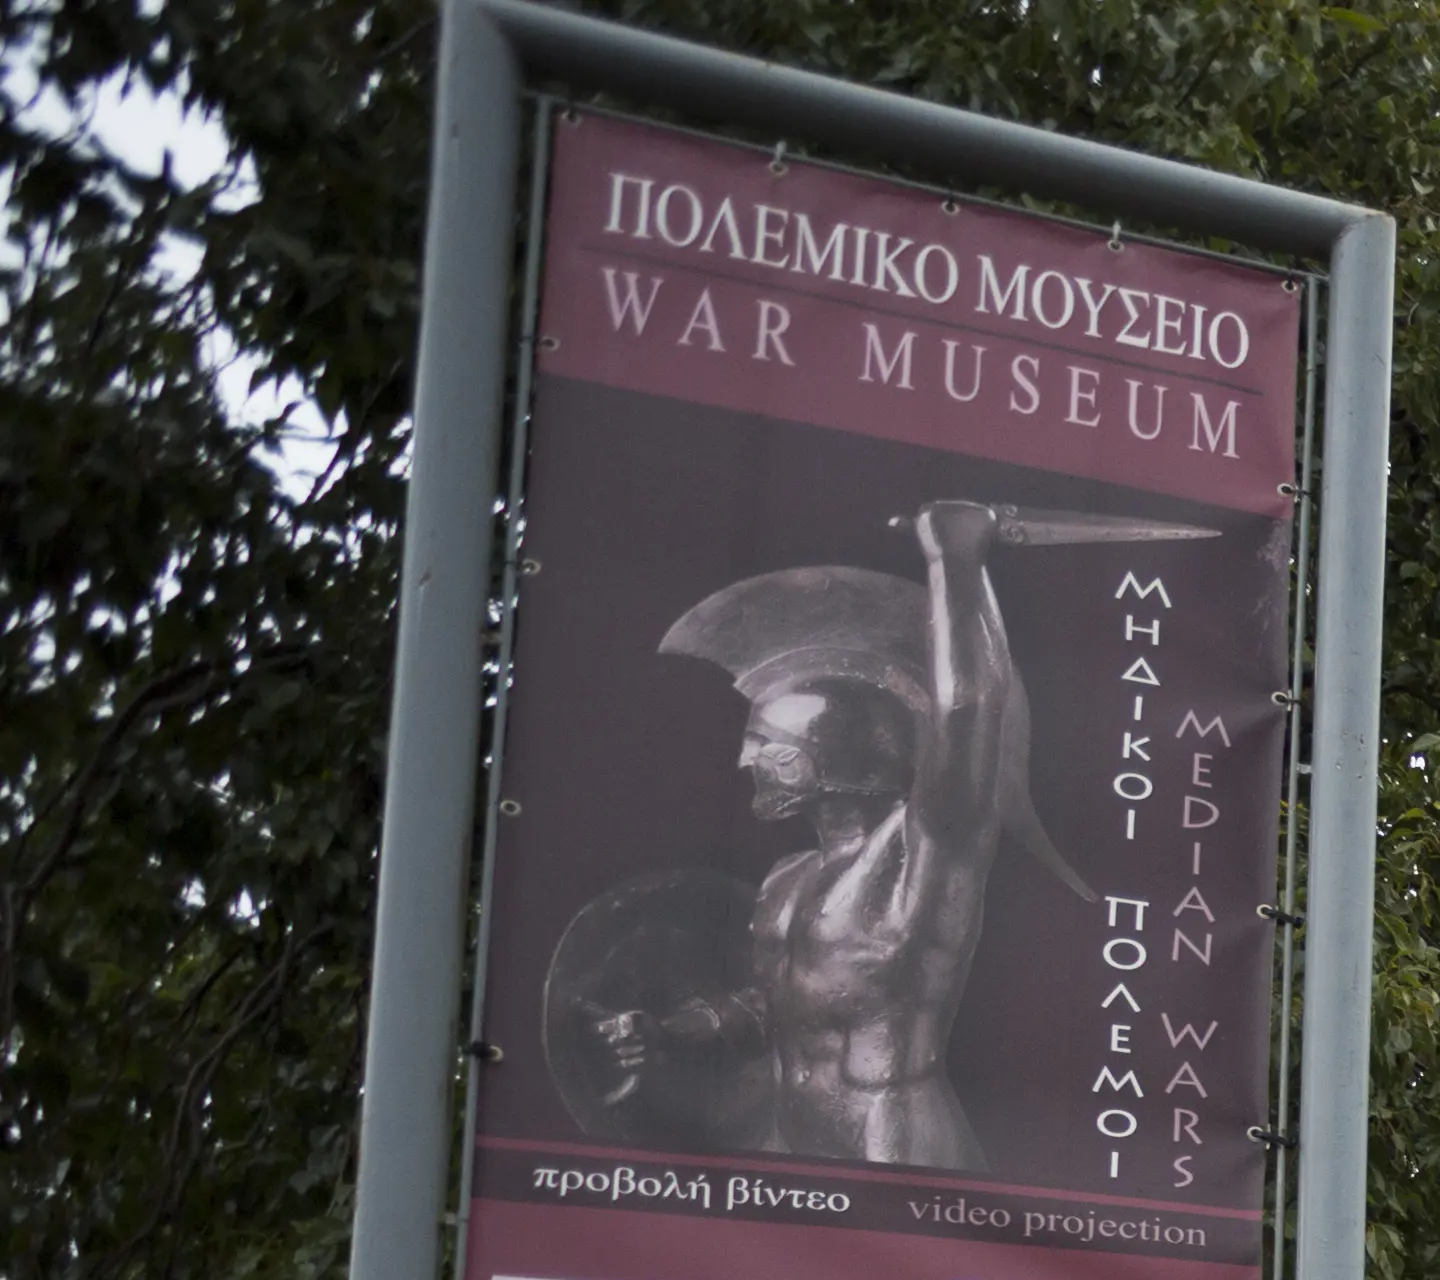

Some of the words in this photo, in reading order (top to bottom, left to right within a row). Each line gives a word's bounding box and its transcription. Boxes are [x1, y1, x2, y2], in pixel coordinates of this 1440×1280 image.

[602, 267, 796, 367] WAR
[861, 323, 1243, 460] MUSEUM
[603, 172, 959, 304] ΠΟΛΕΜΙΚΟ
[976, 255, 1251, 370] ΜΟΥΣΕΙΟ
[1114, 570, 1172, 840] ΜΗΔΙΚΟΙ
[1172, 710, 1232, 966] MEDIAN
[1092, 896, 1150, 1179] ΠΟΛΕΜΟΙ
[1161, 1012, 1218, 1189] WARS
[532, 1163, 711, 1210] προβολή
[725, 1172, 851, 1214] βίντεο
[908, 1195, 1011, 1231] video
[1024, 1207, 1207, 1250] projection
